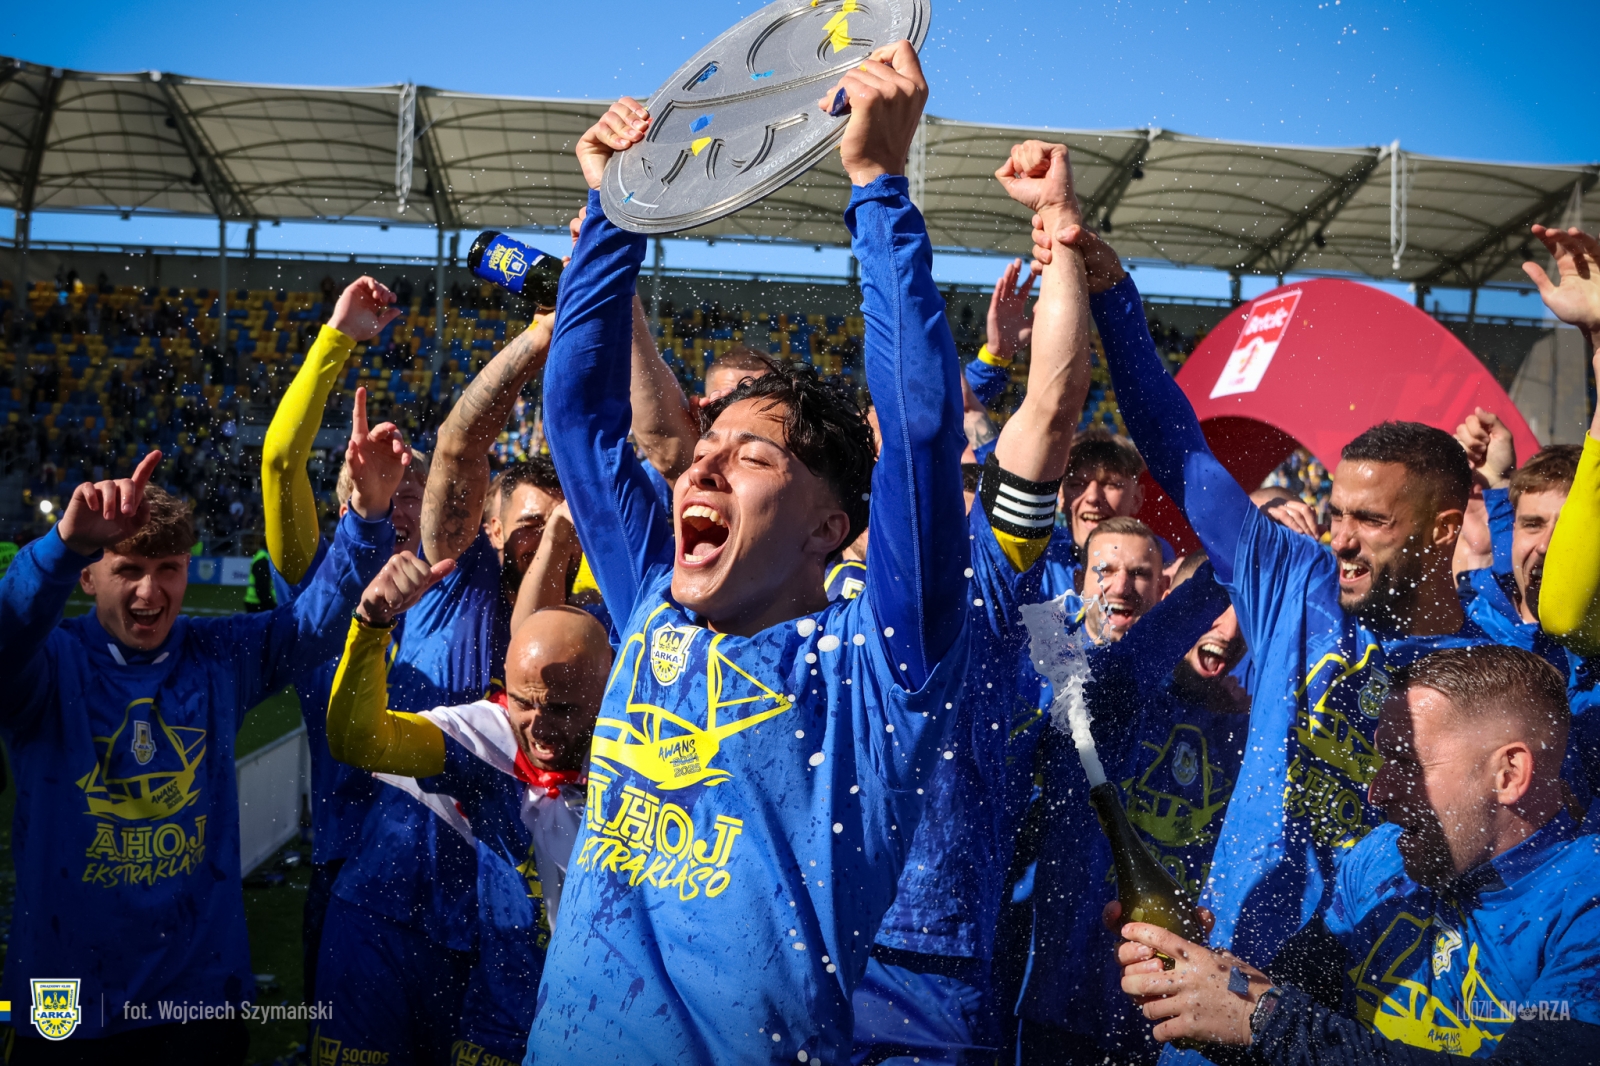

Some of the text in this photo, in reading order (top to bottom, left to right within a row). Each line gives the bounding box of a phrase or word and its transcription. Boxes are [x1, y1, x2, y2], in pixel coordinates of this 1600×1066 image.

[655, 651, 678, 663] ARKA
[658, 739, 696, 762] AWANS
[152, 781, 177, 804] AWANS
[85, 815, 207, 863] AHOJ
[1428, 1028, 1461, 1046] AWANS
[341, 1047, 390, 1065] SOCIOS
